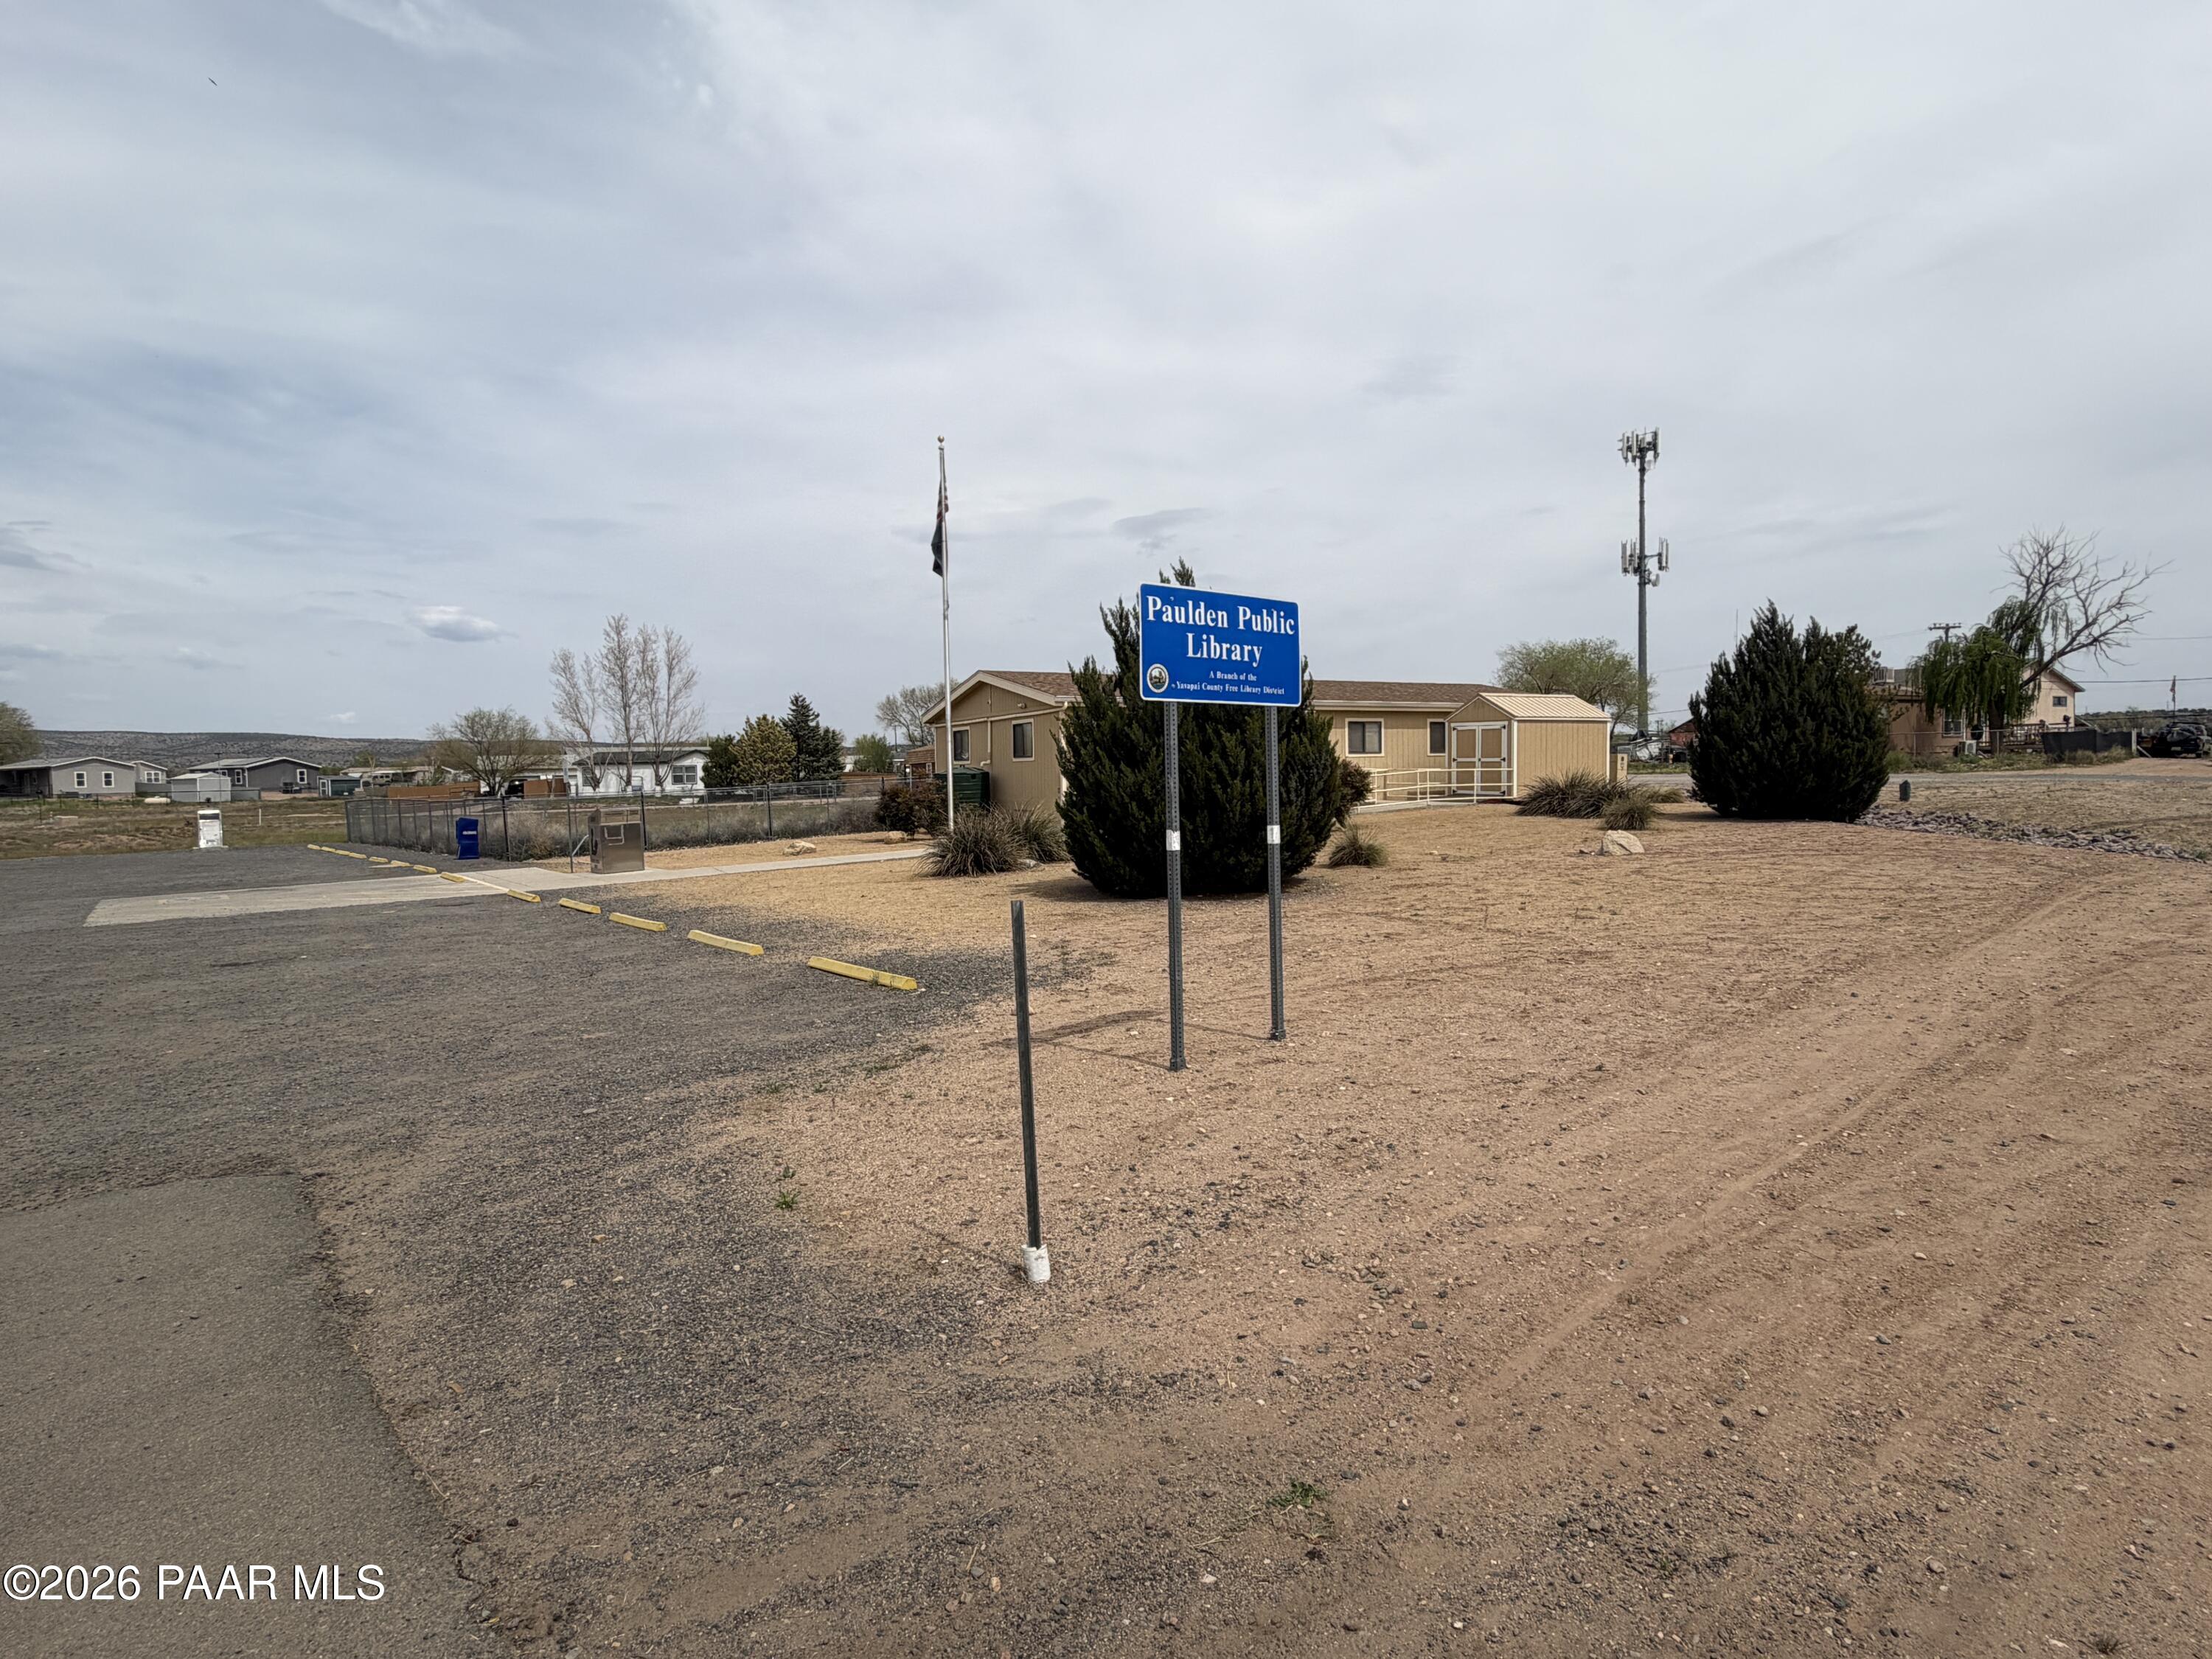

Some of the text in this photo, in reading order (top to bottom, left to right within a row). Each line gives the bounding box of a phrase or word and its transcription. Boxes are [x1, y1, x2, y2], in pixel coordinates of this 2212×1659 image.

[1147, 596, 1295, 635] Paulden Public
[1186, 633, 1262, 667] Library
[1209, 670, 1257, 681] A Branch of the
[1176, 681, 1284, 695] Yavapai County Free Library District
